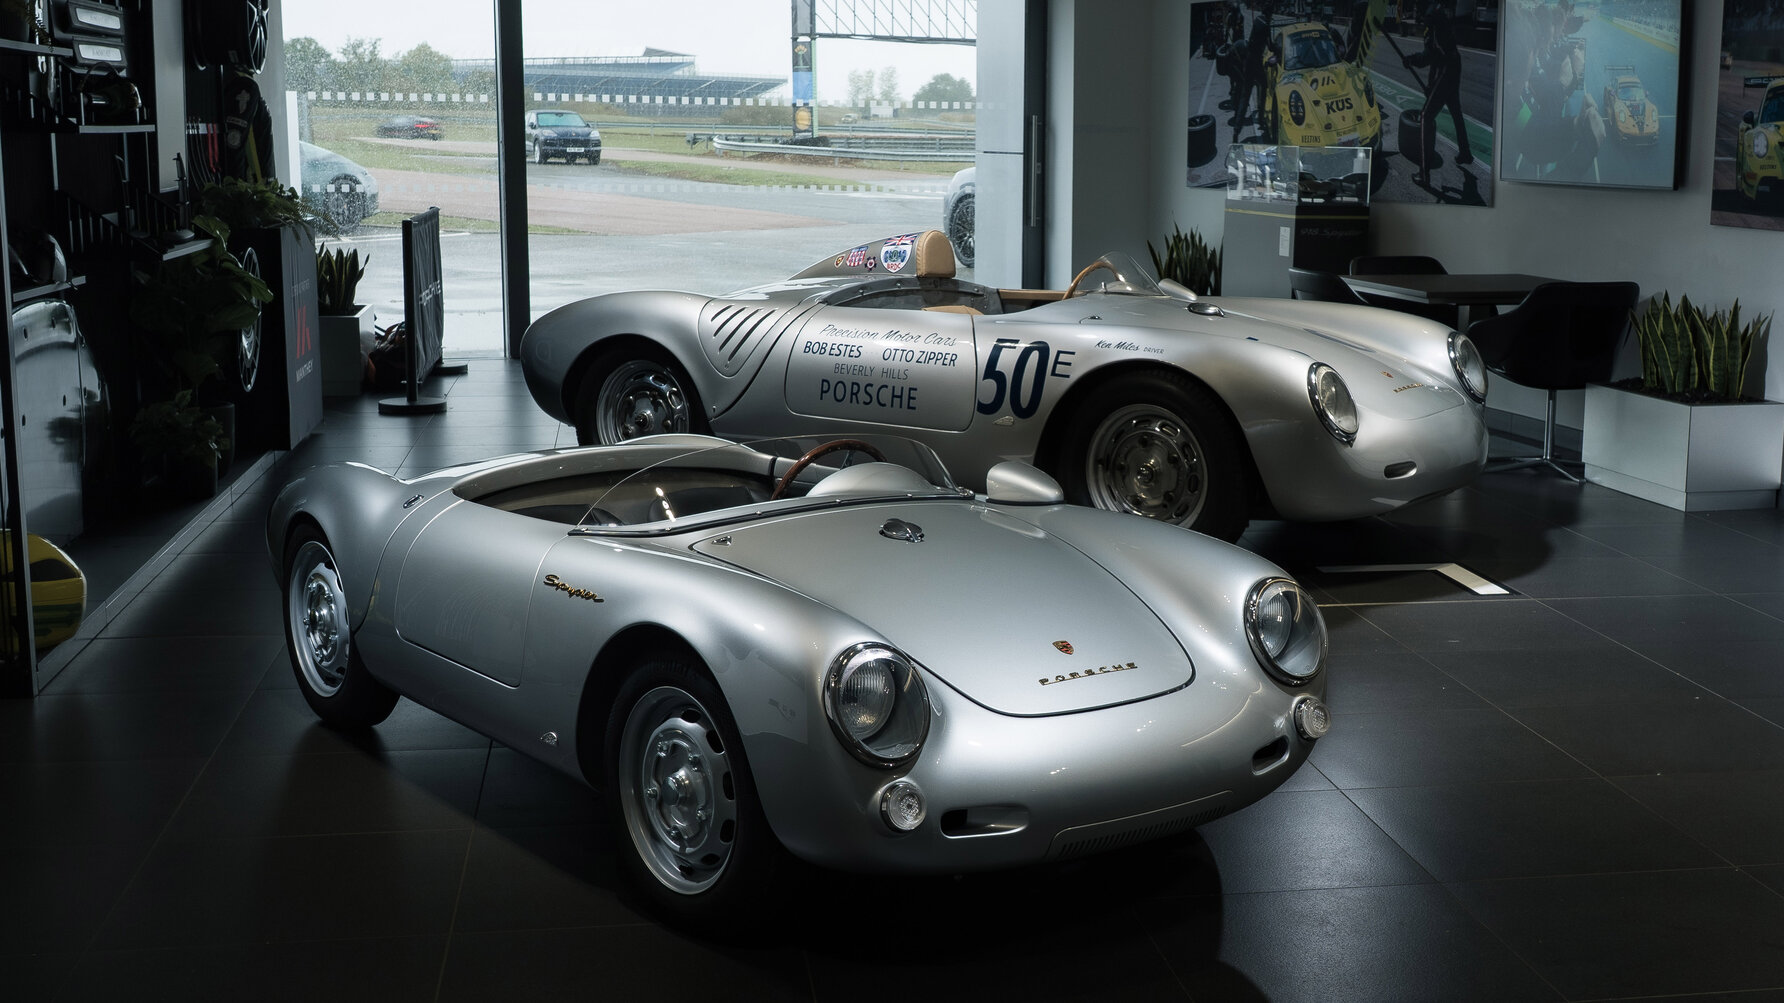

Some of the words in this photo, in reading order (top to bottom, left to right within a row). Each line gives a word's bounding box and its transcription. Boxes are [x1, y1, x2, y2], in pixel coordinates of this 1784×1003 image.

[1325, 97, 1354, 115] KÜS
[820, 324, 880, 340] Precision
[880, 329, 921, 344] Motor
[923, 332, 957, 347] Cars
[1095, 339, 1112, 349] Ken
[1113, 341, 1140, 352] Miles
[803, 340, 828, 355] BOB
[828, 343, 863, 359] ESTES
[882, 347, 915, 363] OTTO
[915, 350, 958, 367] ZIPPER
[833, 362, 876, 377] BEVERLY
[880, 367, 909, 381] HILLS
[976, 338, 1050, 419] 50
[820, 378, 918, 410] PORSCHE
[543, 574, 605, 603] Spyder
[1038, 661, 1138, 686] PORSCHE
